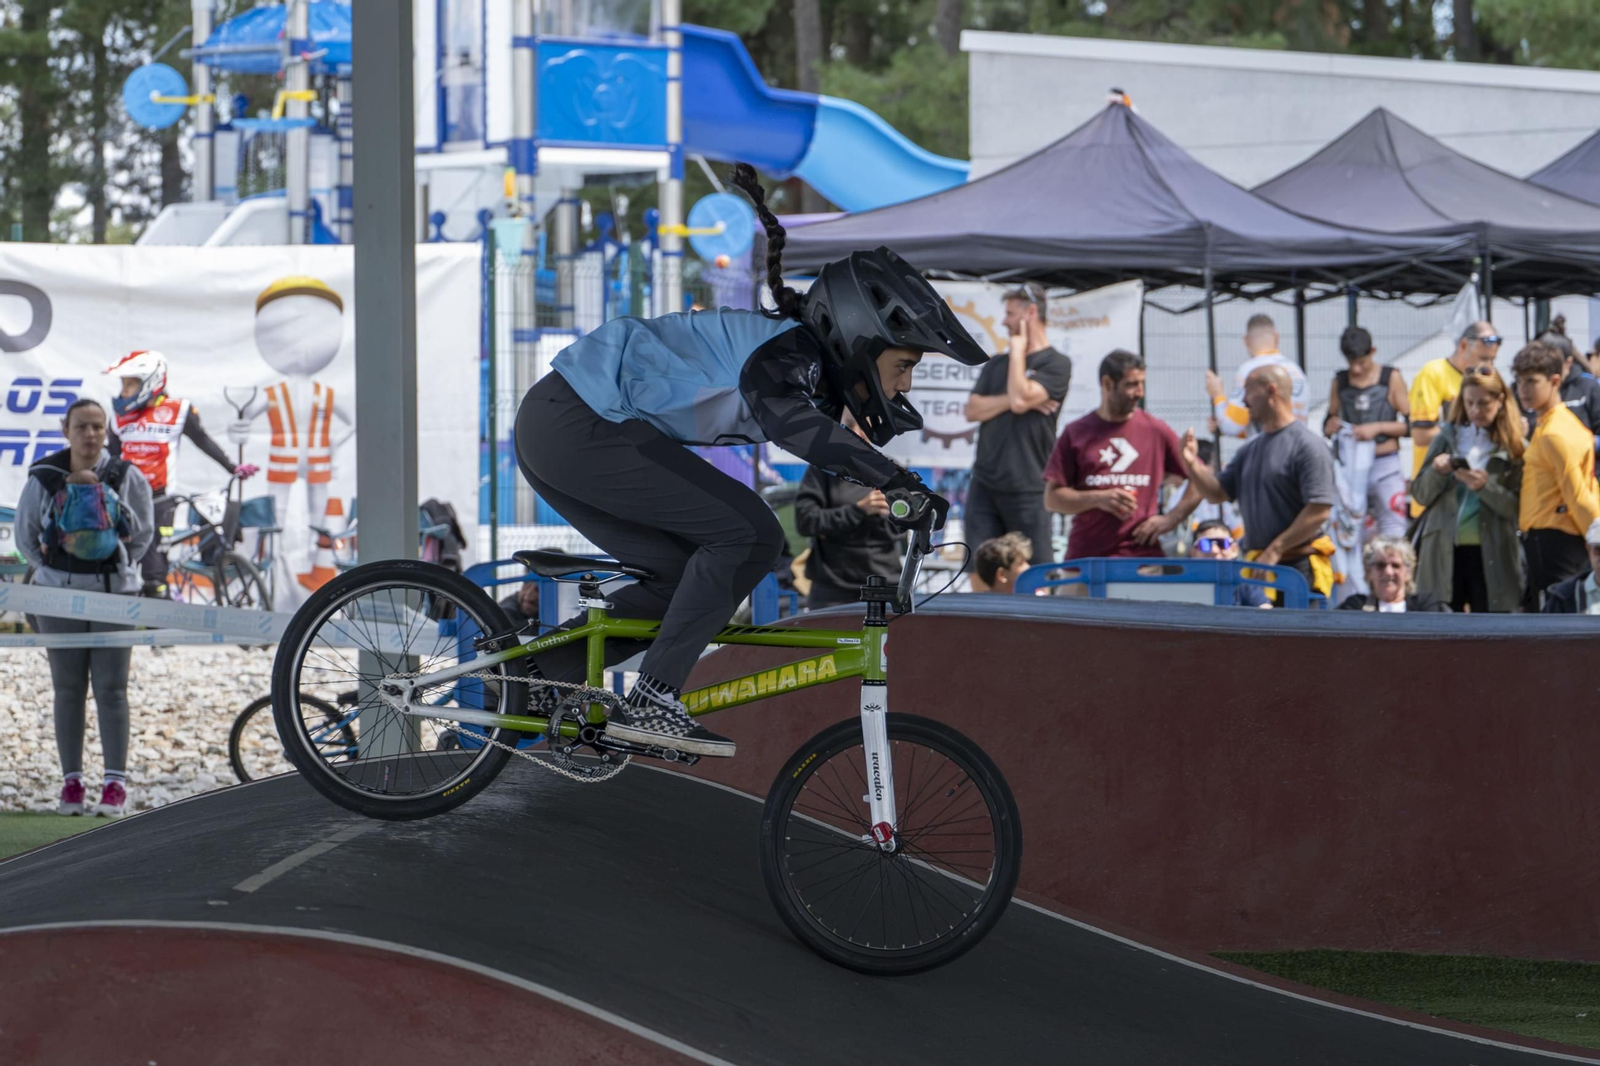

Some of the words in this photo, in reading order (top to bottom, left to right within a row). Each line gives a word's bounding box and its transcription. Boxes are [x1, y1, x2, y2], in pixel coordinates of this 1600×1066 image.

[0, 377, 82, 413] OS
[919, 400, 966, 416] TEA
[1085, 474, 1150, 486] CONVERSE
[526, 634, 569, 651] Clotho
[792, 752, 817, 778] MAXXIS
[442, 777, 471, 797] MAXXIS
